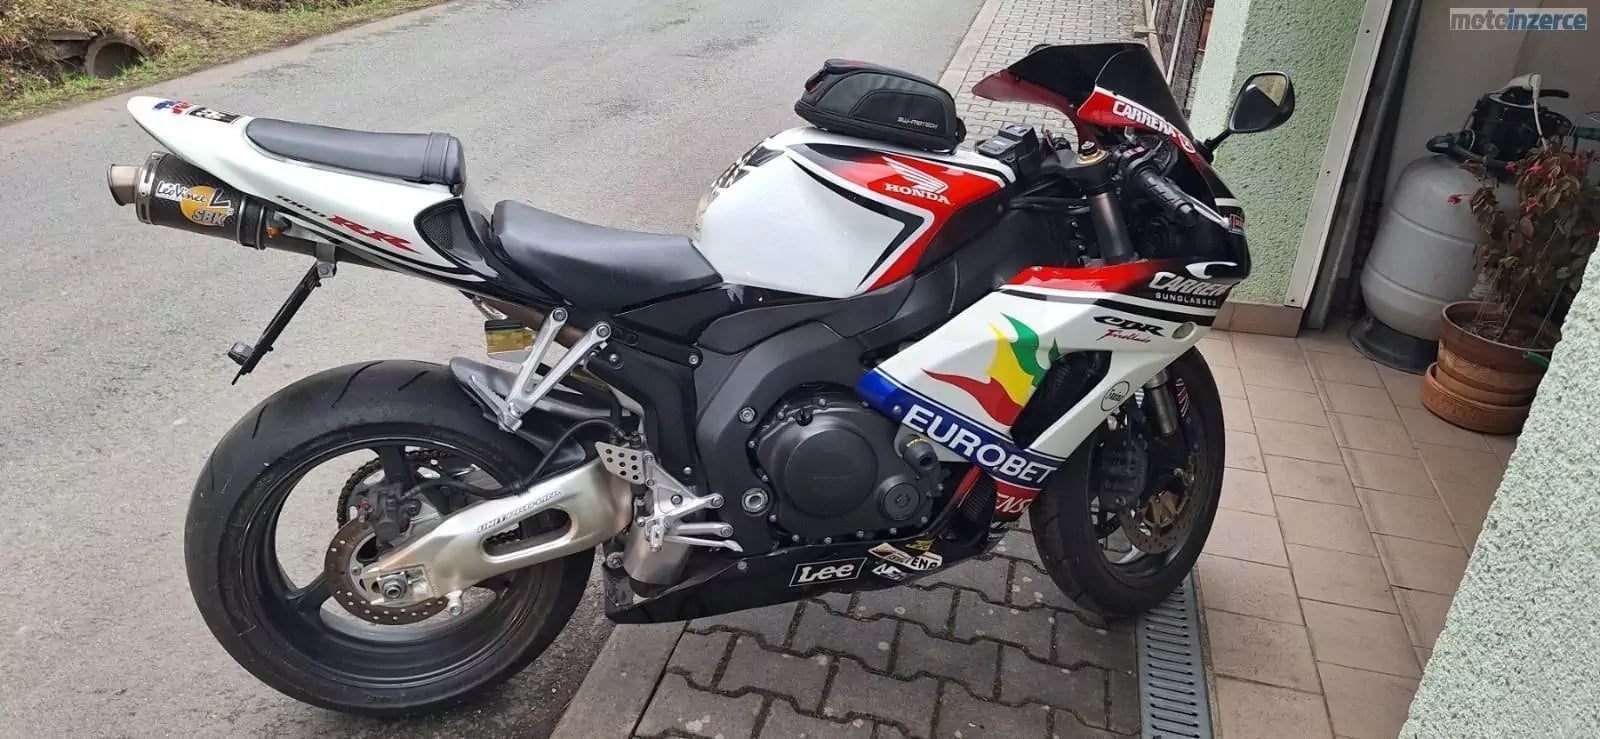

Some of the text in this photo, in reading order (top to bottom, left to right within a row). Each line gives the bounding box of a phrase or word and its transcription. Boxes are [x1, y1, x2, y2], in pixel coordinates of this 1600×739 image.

[883, 183, 951, 205] HONDA
[1155, 291, 1217, 307] SUNGLASSES
[1093, 314, 1166, 338] CBR
[901, 403, 1058, 485] EUROBET
[797, 562, 855, 584] Lee
